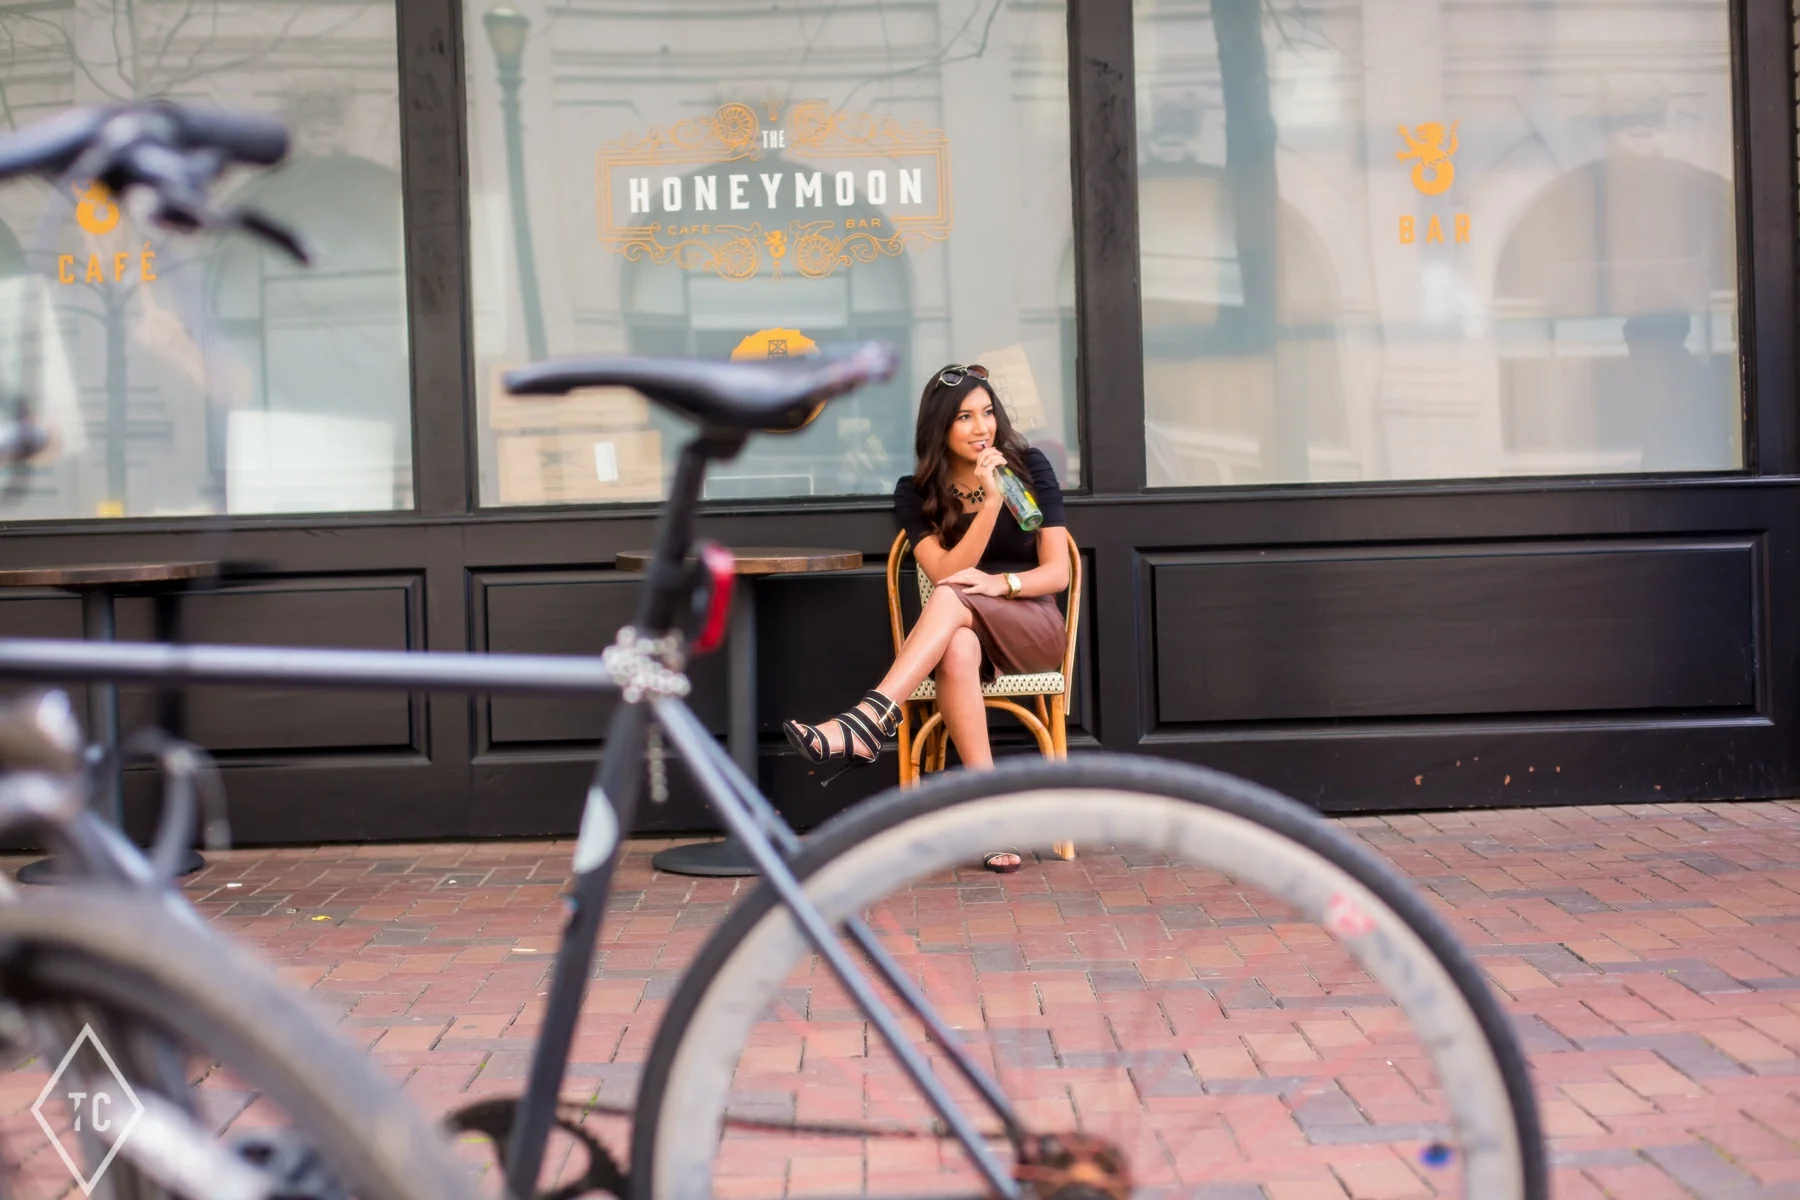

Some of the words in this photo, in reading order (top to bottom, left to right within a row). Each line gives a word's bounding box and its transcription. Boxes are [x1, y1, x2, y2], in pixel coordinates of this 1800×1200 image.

[762, 130, 786, 148] THE
[629, 168, 923, 213] HONEYMOON
[845, 218, 881, 229] BAR
[1399, 214, 1471, 244] BAR
[58, 241, 157, 284] CAFÉ
